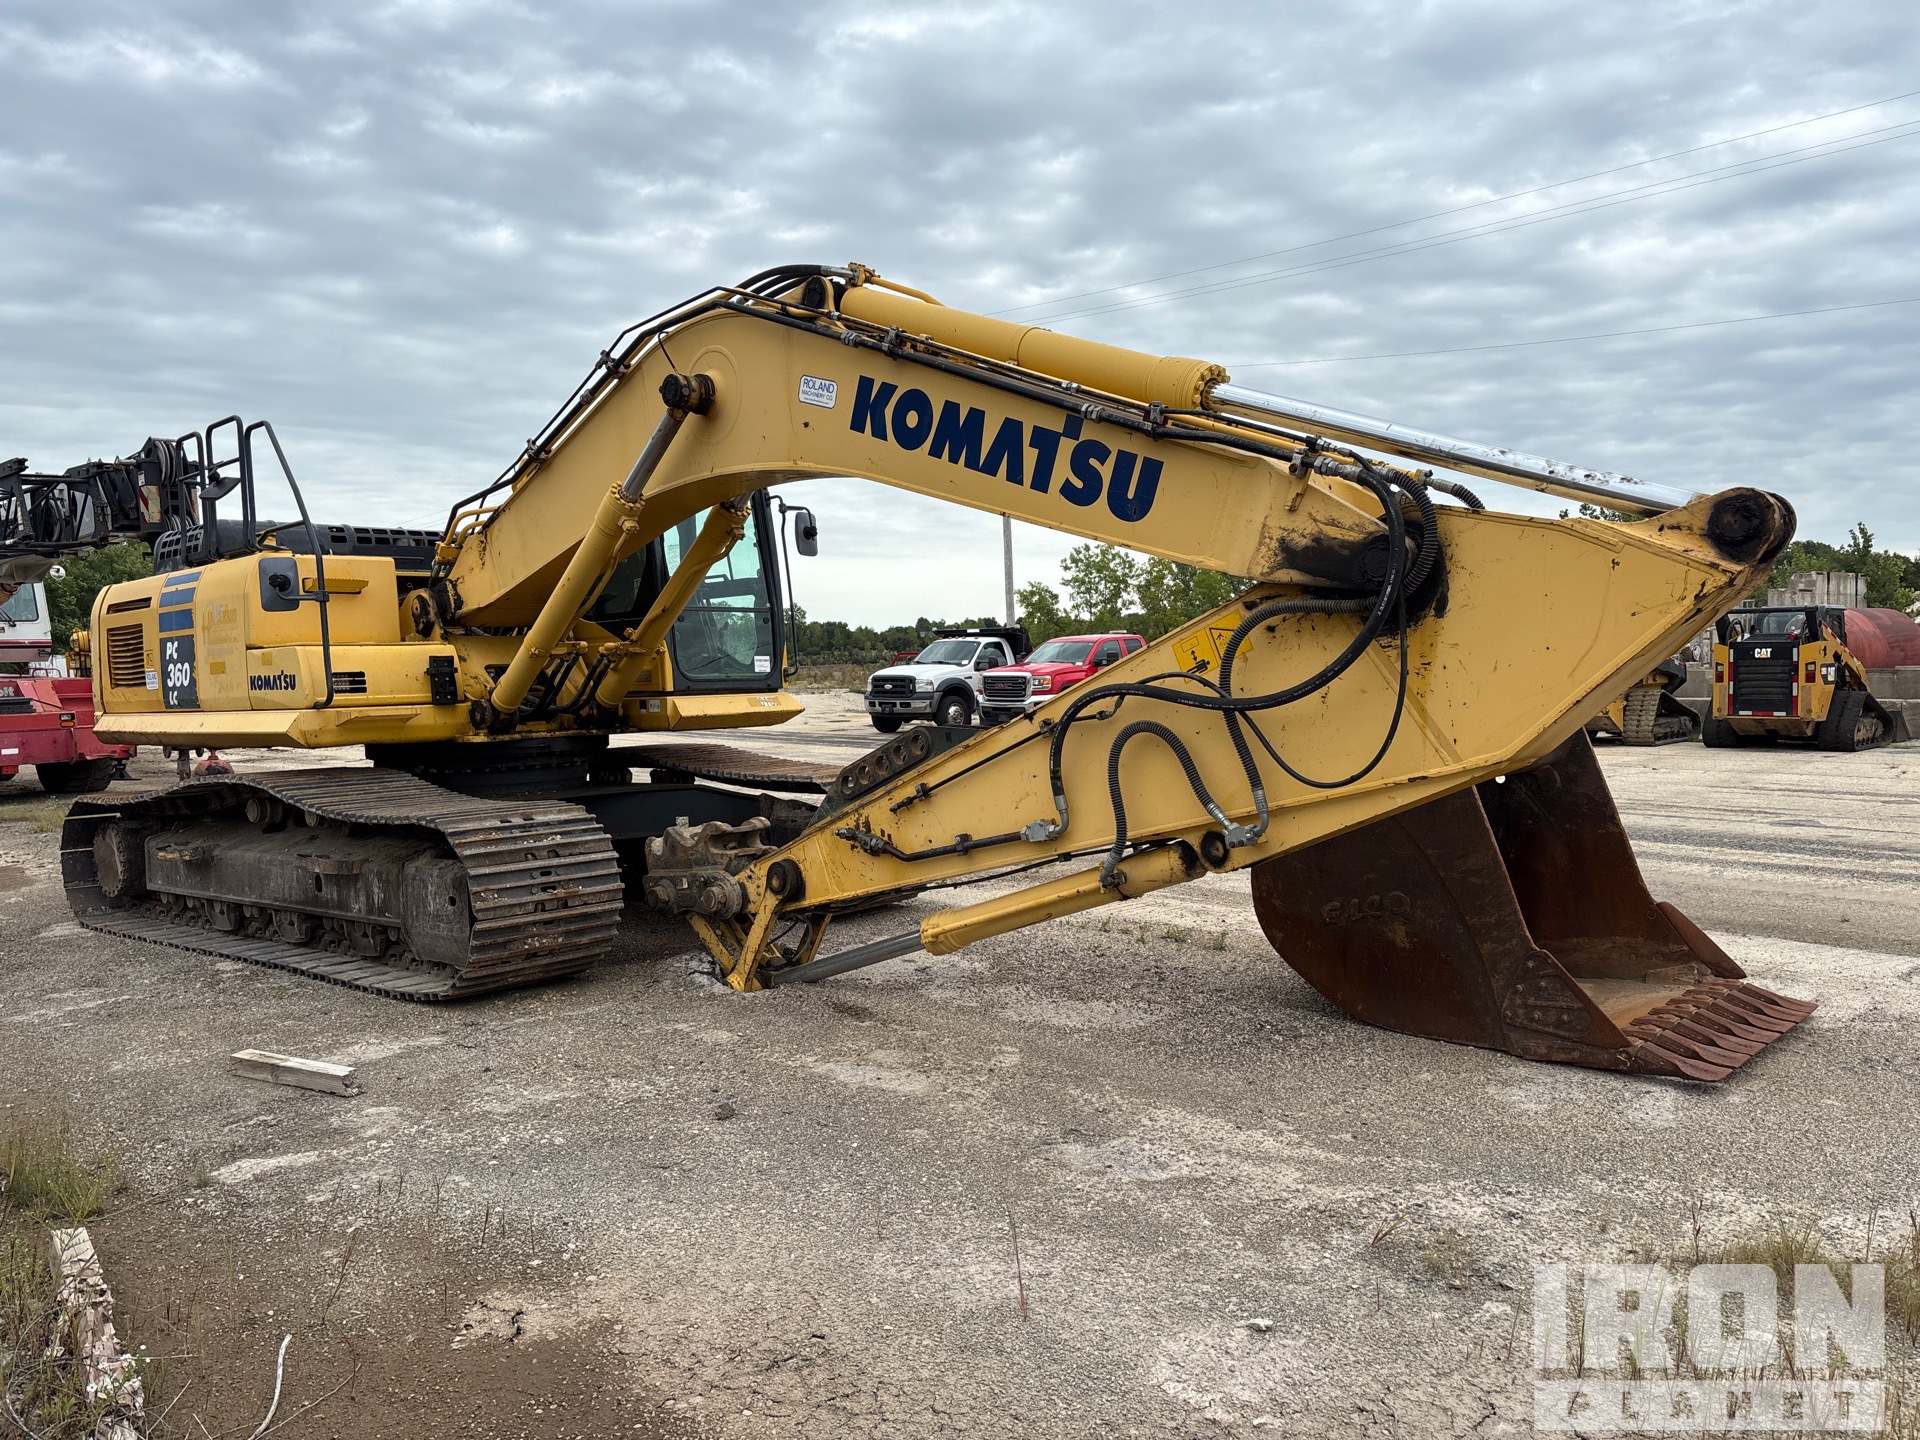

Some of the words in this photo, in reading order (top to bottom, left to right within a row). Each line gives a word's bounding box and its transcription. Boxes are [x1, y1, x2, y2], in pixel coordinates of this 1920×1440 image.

[801, 389, 825, 399] MACHINERY
[803, 378, 835, 393] ROLAND
[850, 375, 1164, 522] KOMATSU
[166, 641, 178, 660] PC
[1754, 648, 1772, 658] CAT
[167, 662, 190, 687] 360
[250, 670, 296, 690] KOMATSU
[169, 690, 178, 705] LC
